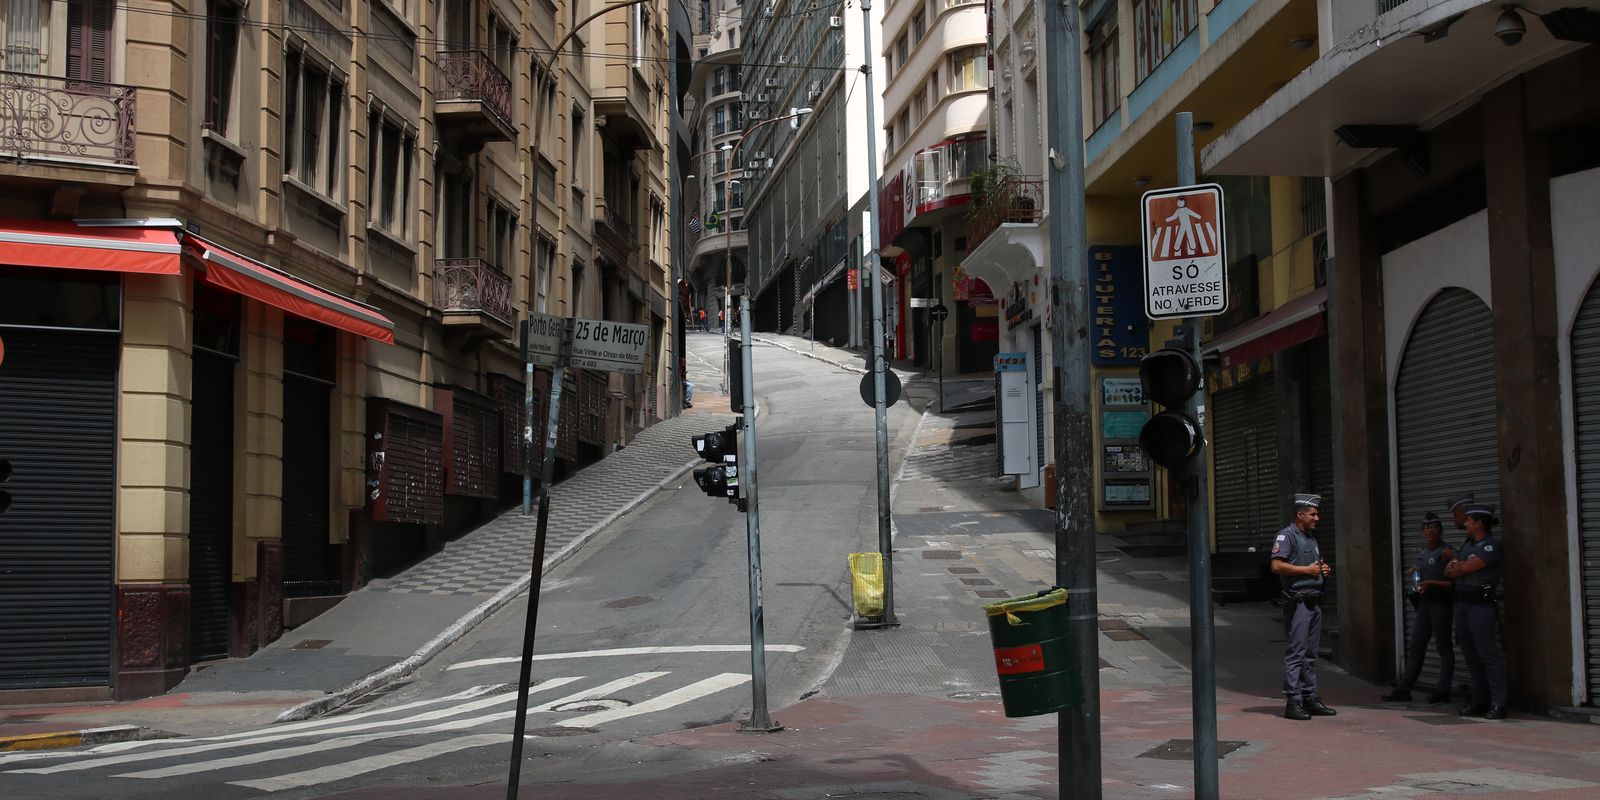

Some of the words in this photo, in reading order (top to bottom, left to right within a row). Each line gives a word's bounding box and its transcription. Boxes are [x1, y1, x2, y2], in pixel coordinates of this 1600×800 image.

[1172, 260, 1199, 280] SÓ
[1152, 281, 1221, 297] ATRAVESSE
[1094, 252, 1117, 358] BIJUTERIAS
[1154, 299, 1172, 310] NO
[1178, 295, 1220, 309] VERDE
[529, 315, 547, 336] Porto
[548, 318, 561, 338] Gera
[575, 321, 590, 340] 25
[593, 322, 608, 341] de
[612, 325, 645, 350] Março
[573, 346, 583, 355] Rua
[584, 348, 597, 356] Vinte
[603, 350, 618, 359] Cinco
[626, 353, 639, 361] Março
[1120, 347, 1146, 358] 123
